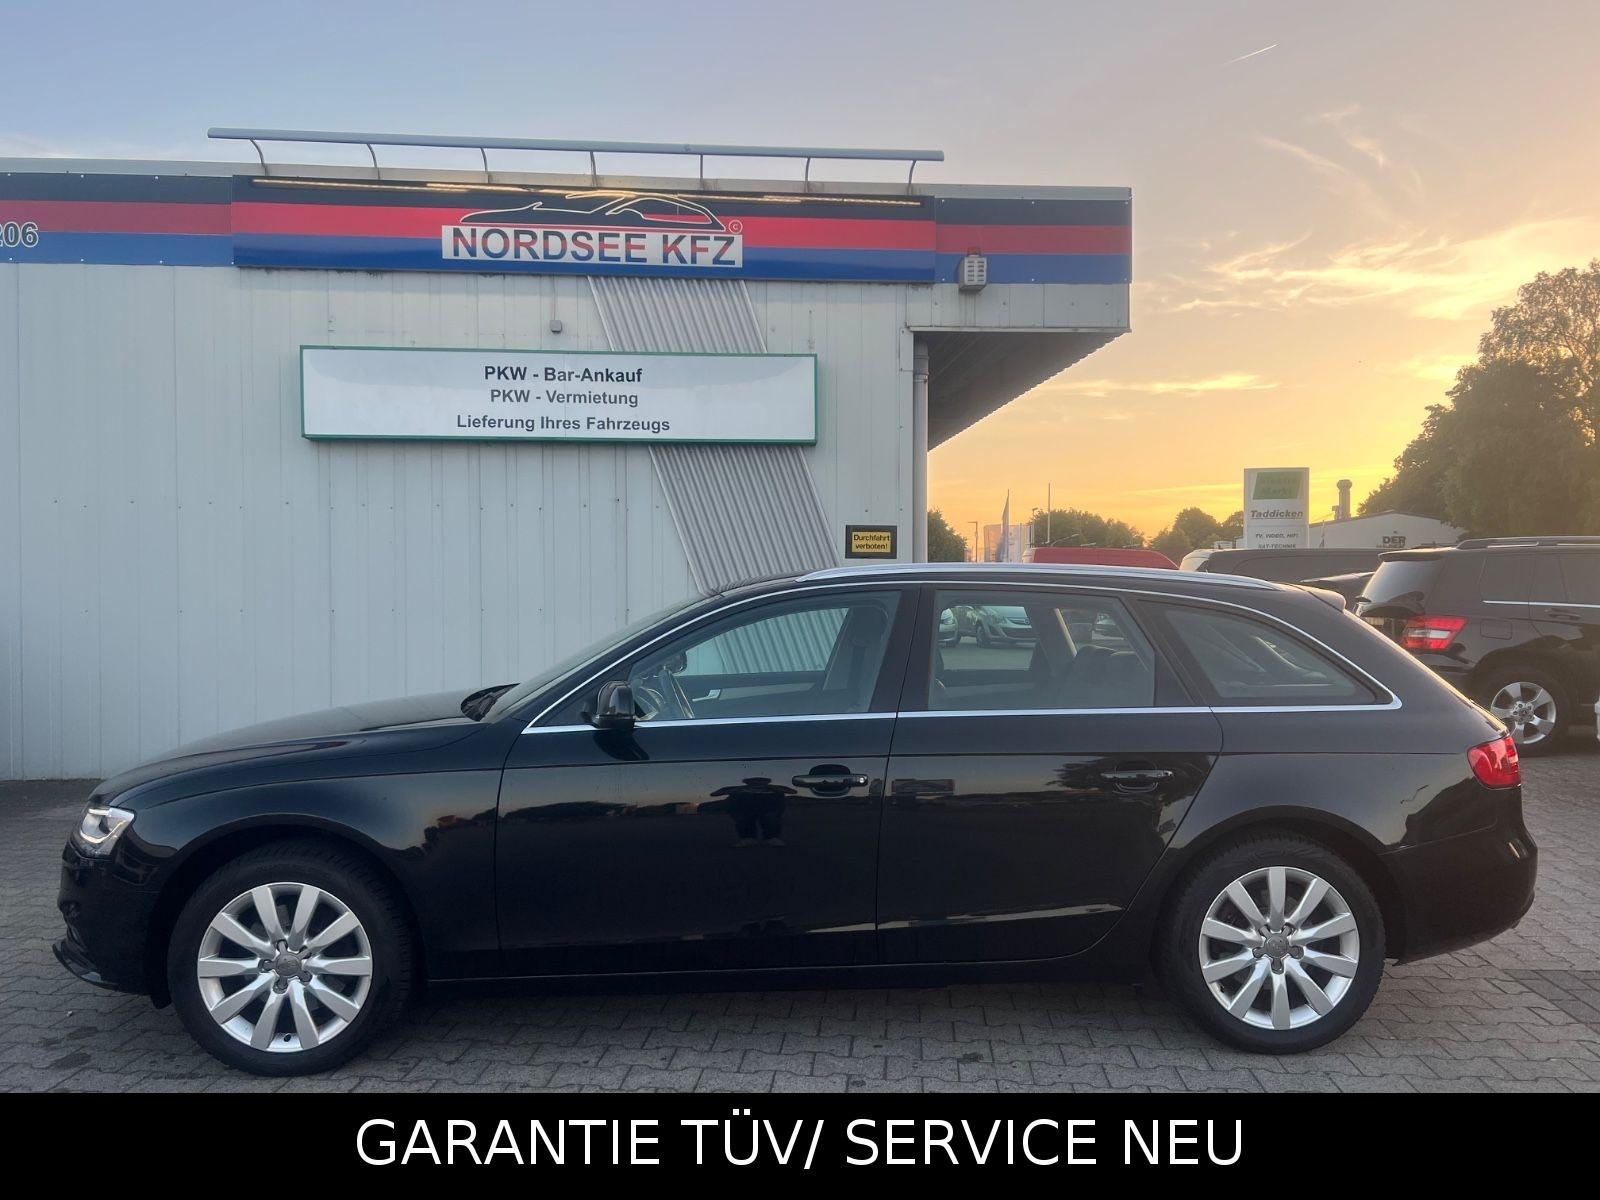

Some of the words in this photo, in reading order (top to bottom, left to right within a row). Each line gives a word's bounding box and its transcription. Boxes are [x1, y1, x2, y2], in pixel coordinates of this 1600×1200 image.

[0, 221, 39, 247] 06
[453, 228, 647, 263] NORDSEE
[663, 234, 736, 266] KFZ
[484, 366, 527, 381] PKW
[544, 367, 643, 383] Bar-Ankauf
[490, 389, 530, 403] PKW
[546, 390, 639, 407] Vermietung
[457, 415, 535, 432] Lieferung
[540, 416, 581, 430] Ihres
[586, 416, 671, 432] Fahrzeugs
[1250, 509, 1304, 518] Taddicken
[1382, 535, 1406, 544] DER
